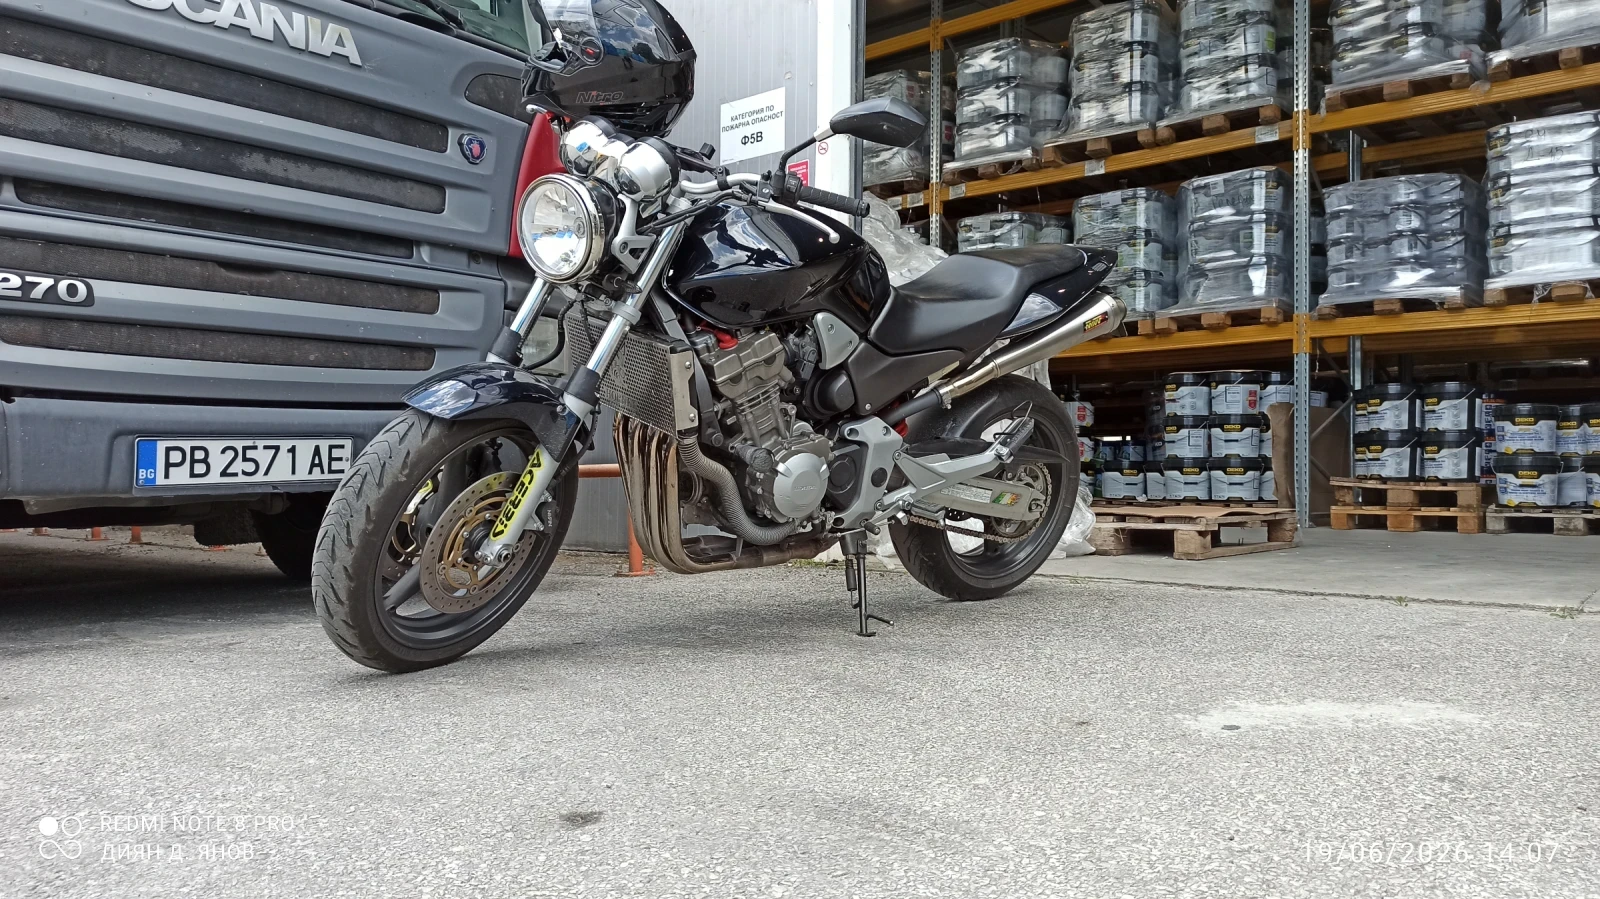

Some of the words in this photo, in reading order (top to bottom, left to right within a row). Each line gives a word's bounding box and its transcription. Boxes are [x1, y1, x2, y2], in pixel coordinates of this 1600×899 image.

[127, 0, 362, 66] CANIA
[576, 91, 624, 103] Nitro
[722, 121, 750, 133] ПОЖАРНА
[751, 111, 784, 125] ОПАСНОСТ
[731, 107, 764, 122] КАТЕГОРИЯ
[765, 105, 775, 113] ПО
[741, 131, 764, 146] Ф5В
[164, 445, 211, 480] PB
[220, 444, 297, 478] 2571
[307, 444, 346, 475] AE
[138, 469, 155, 479] BG
